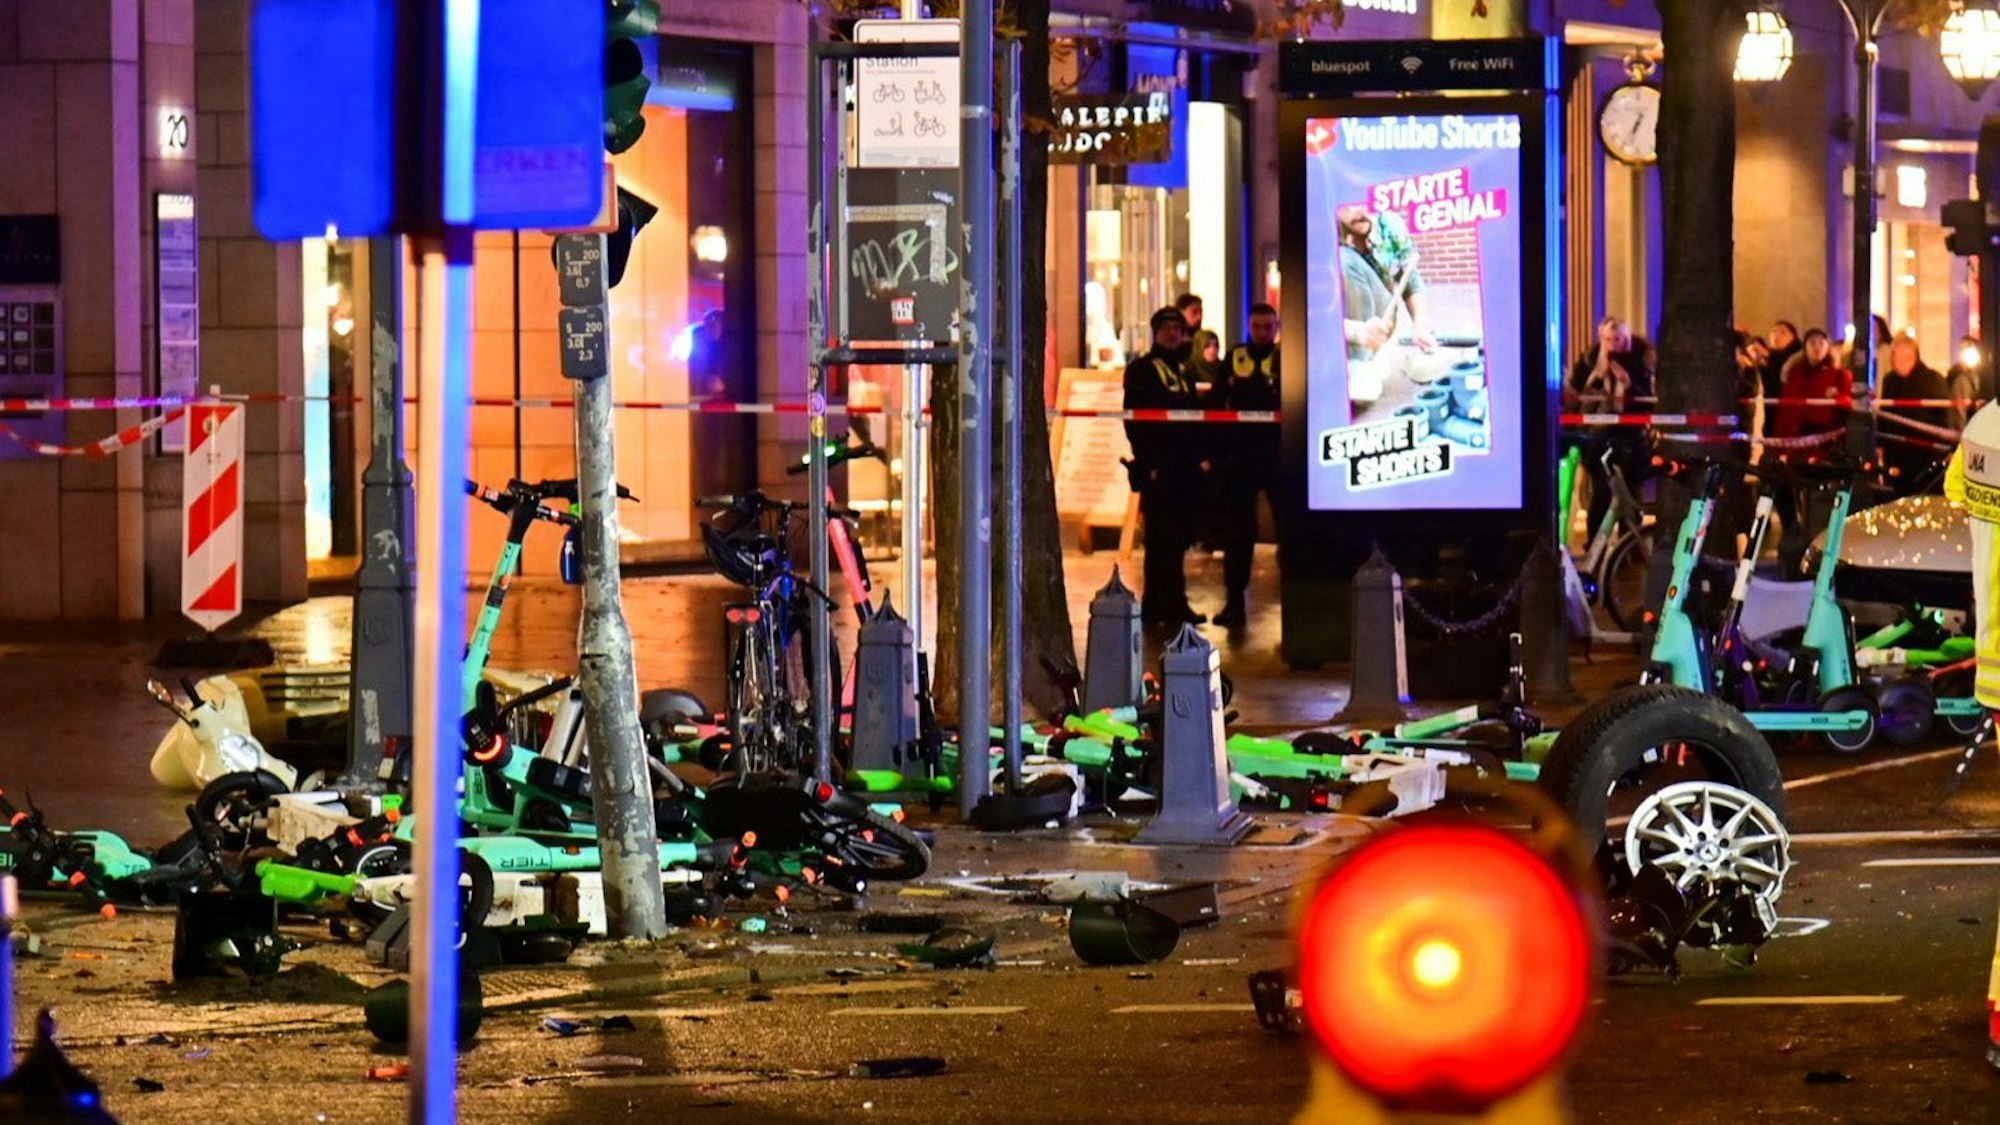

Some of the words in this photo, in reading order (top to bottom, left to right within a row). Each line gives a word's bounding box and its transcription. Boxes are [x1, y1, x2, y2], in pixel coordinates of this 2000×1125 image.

[1311, 61, 1370, 74] bluespot
[1450, 58, 1478, 70] Free
[1483, 58, 1513, 70] WiFi
[1341, 117, 1439, 151] YouTube
[1441, 115, 1521, 150] Shorts
[1373, 168, 1463, 212] STARTE
[1413, 190, 1501, 231] GENIAL
[583, 249, 600, 261] 200
[585, 321, 603, 333] 200
[1328, 421, 1410, 460] STARTE
[1356, 446, 1443, 485] SHORTS
[500, 857, 549, 869] TIER
